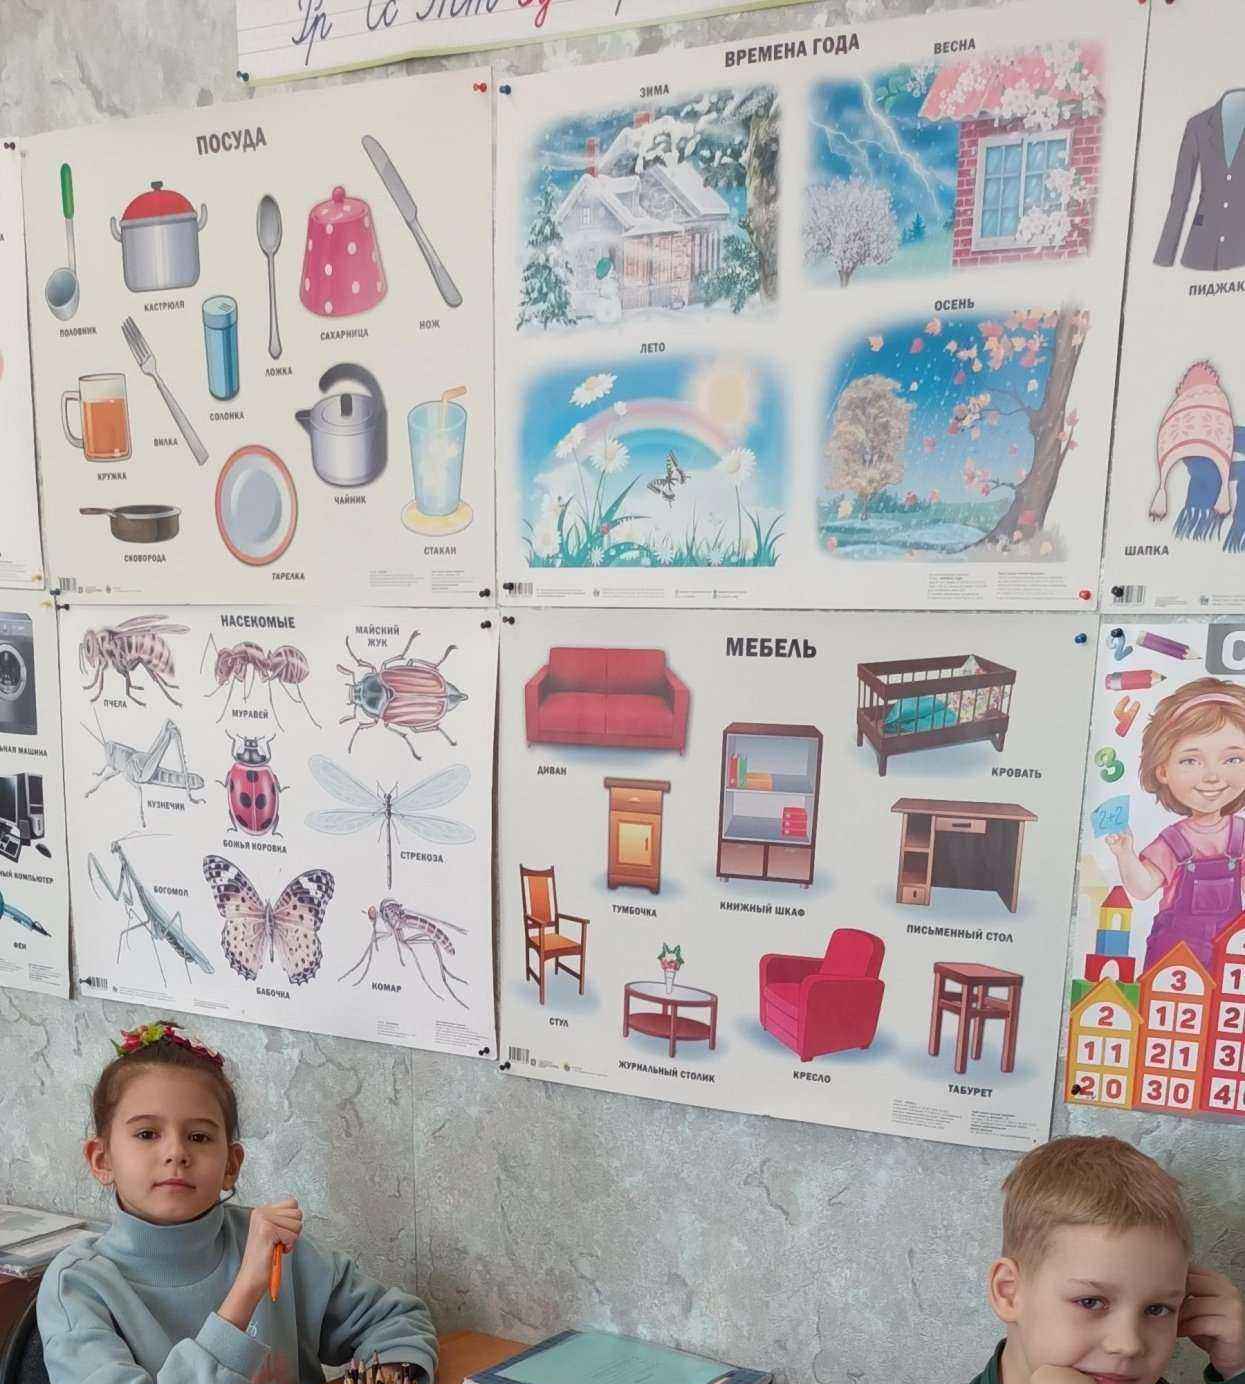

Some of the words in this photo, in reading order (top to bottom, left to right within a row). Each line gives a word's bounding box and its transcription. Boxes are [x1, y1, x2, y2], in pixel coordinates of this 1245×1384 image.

[725, 40, 808, 68] ВРЕМЕНА
[813, 33, 860, 56] ГОДА
[933, 38, 976, 55] ВЕСНА
[639, 84, 670, 98] ЗИМА
[196, 127, 268, 155] ПОСУДА
[144, 300, 185, 312] КАСТРЮЛЯ
[934, 297, 975, 313] ОСЕНЬ
[419, 319, 441, 331] НОЖ
[59, 327, 98, 338] ПОЛОВНИК
[320, 328, 369, 341] САХАРНИЦА
[640, 342, 666, 354] ЛЕТО
[265, 366, 293, 378] ЛОЖКА
[209, 411, 245, 421] СОЛОНКА
[153, 437, 178, 447] ВИЛКА
[97, 471, 127, 481] КРУЖКА
[334, 495, 367, 505] ЧАЙНИК
[424, 545, 457, 556] СТАКАН
[1125, 545, 1169, 556] ШАПКА
[124, 554, 167, 563] СКОВОРОДА
[272, 572, 305, 581] ТАРЕЛКА
[221, 614, 295, 629] НАСЕКОМЫЕ
[355, 624, 400, 636] МАЙСКИЙ
[368, 637, 388, 648] ЖУК
[726, 637, 817, 659] МЕБЕЛЬ
[104, 698, 127, 709] ПЧЕЛА
[232, 707, 269, 720] МУРАВЕЙ
[537, 765, 567, 777] ДИВАН
[991, 767, 1042, 780] КРОВАТЬ
[147, 800, 186, 812] КУЗНЕЧИК
[223, 838, 250, 850] БОЖЬЯ
[251, 841, 287, 853] КОРОВКА
[400, 851, 444, 863] СТРЕКОЗА
[153, 885, 189, 897] БОГОМОЛ
[612, 904, 657, 919] ТУМБОЧКА
[719, 900, 769, 915] КНИЖНЫЙ
[771, 904, 806, 917] ШКАФ
[906, 924, 982, 941] ПИСЬМЕННЫЙ
[985, 929, 1014, 943] СТОЛ
[1171, 970, 1187, 991] 3
[1230, 968, 1241, 990] 1
[256, 987, 290, 1000] БАБОЧКА
[371, 982, 402, 993] КОМАР
[549, 1016, 569, 1028] СТУЛ
[1098, 1006, 1114, 1027] 2
[1156, 1006, 1168, 1026] 1
[1180, 1008, 1197, 1029] 2
[1223, 1007, 1240, 1028] 2
[1084, 1041, 1095, 1061] 1
[1111, 1043, 1122, 1063] 1
[1150, 1043, 1167, 1064] 2
[1179, 1047, 1190, 1067] 1
[1219, 1045, 1236, 1067] 3
[618, 1060, 677, 1080] ЖУРНАЛЬНЫЙ
[679, 1066, 716, 1083] СТОЛИК
[792, 1071, 831, 1084] КРЕСЛО
[948, 1083, 993, 1099] ТАБУРЕТ
[1106, 1078, 1121, 1099] 0
[1147, 1080, 1162, 1101] 3
[1173, 1083, 1190, 1104] 0
[1213, 1084, 1231, 1105] 4
